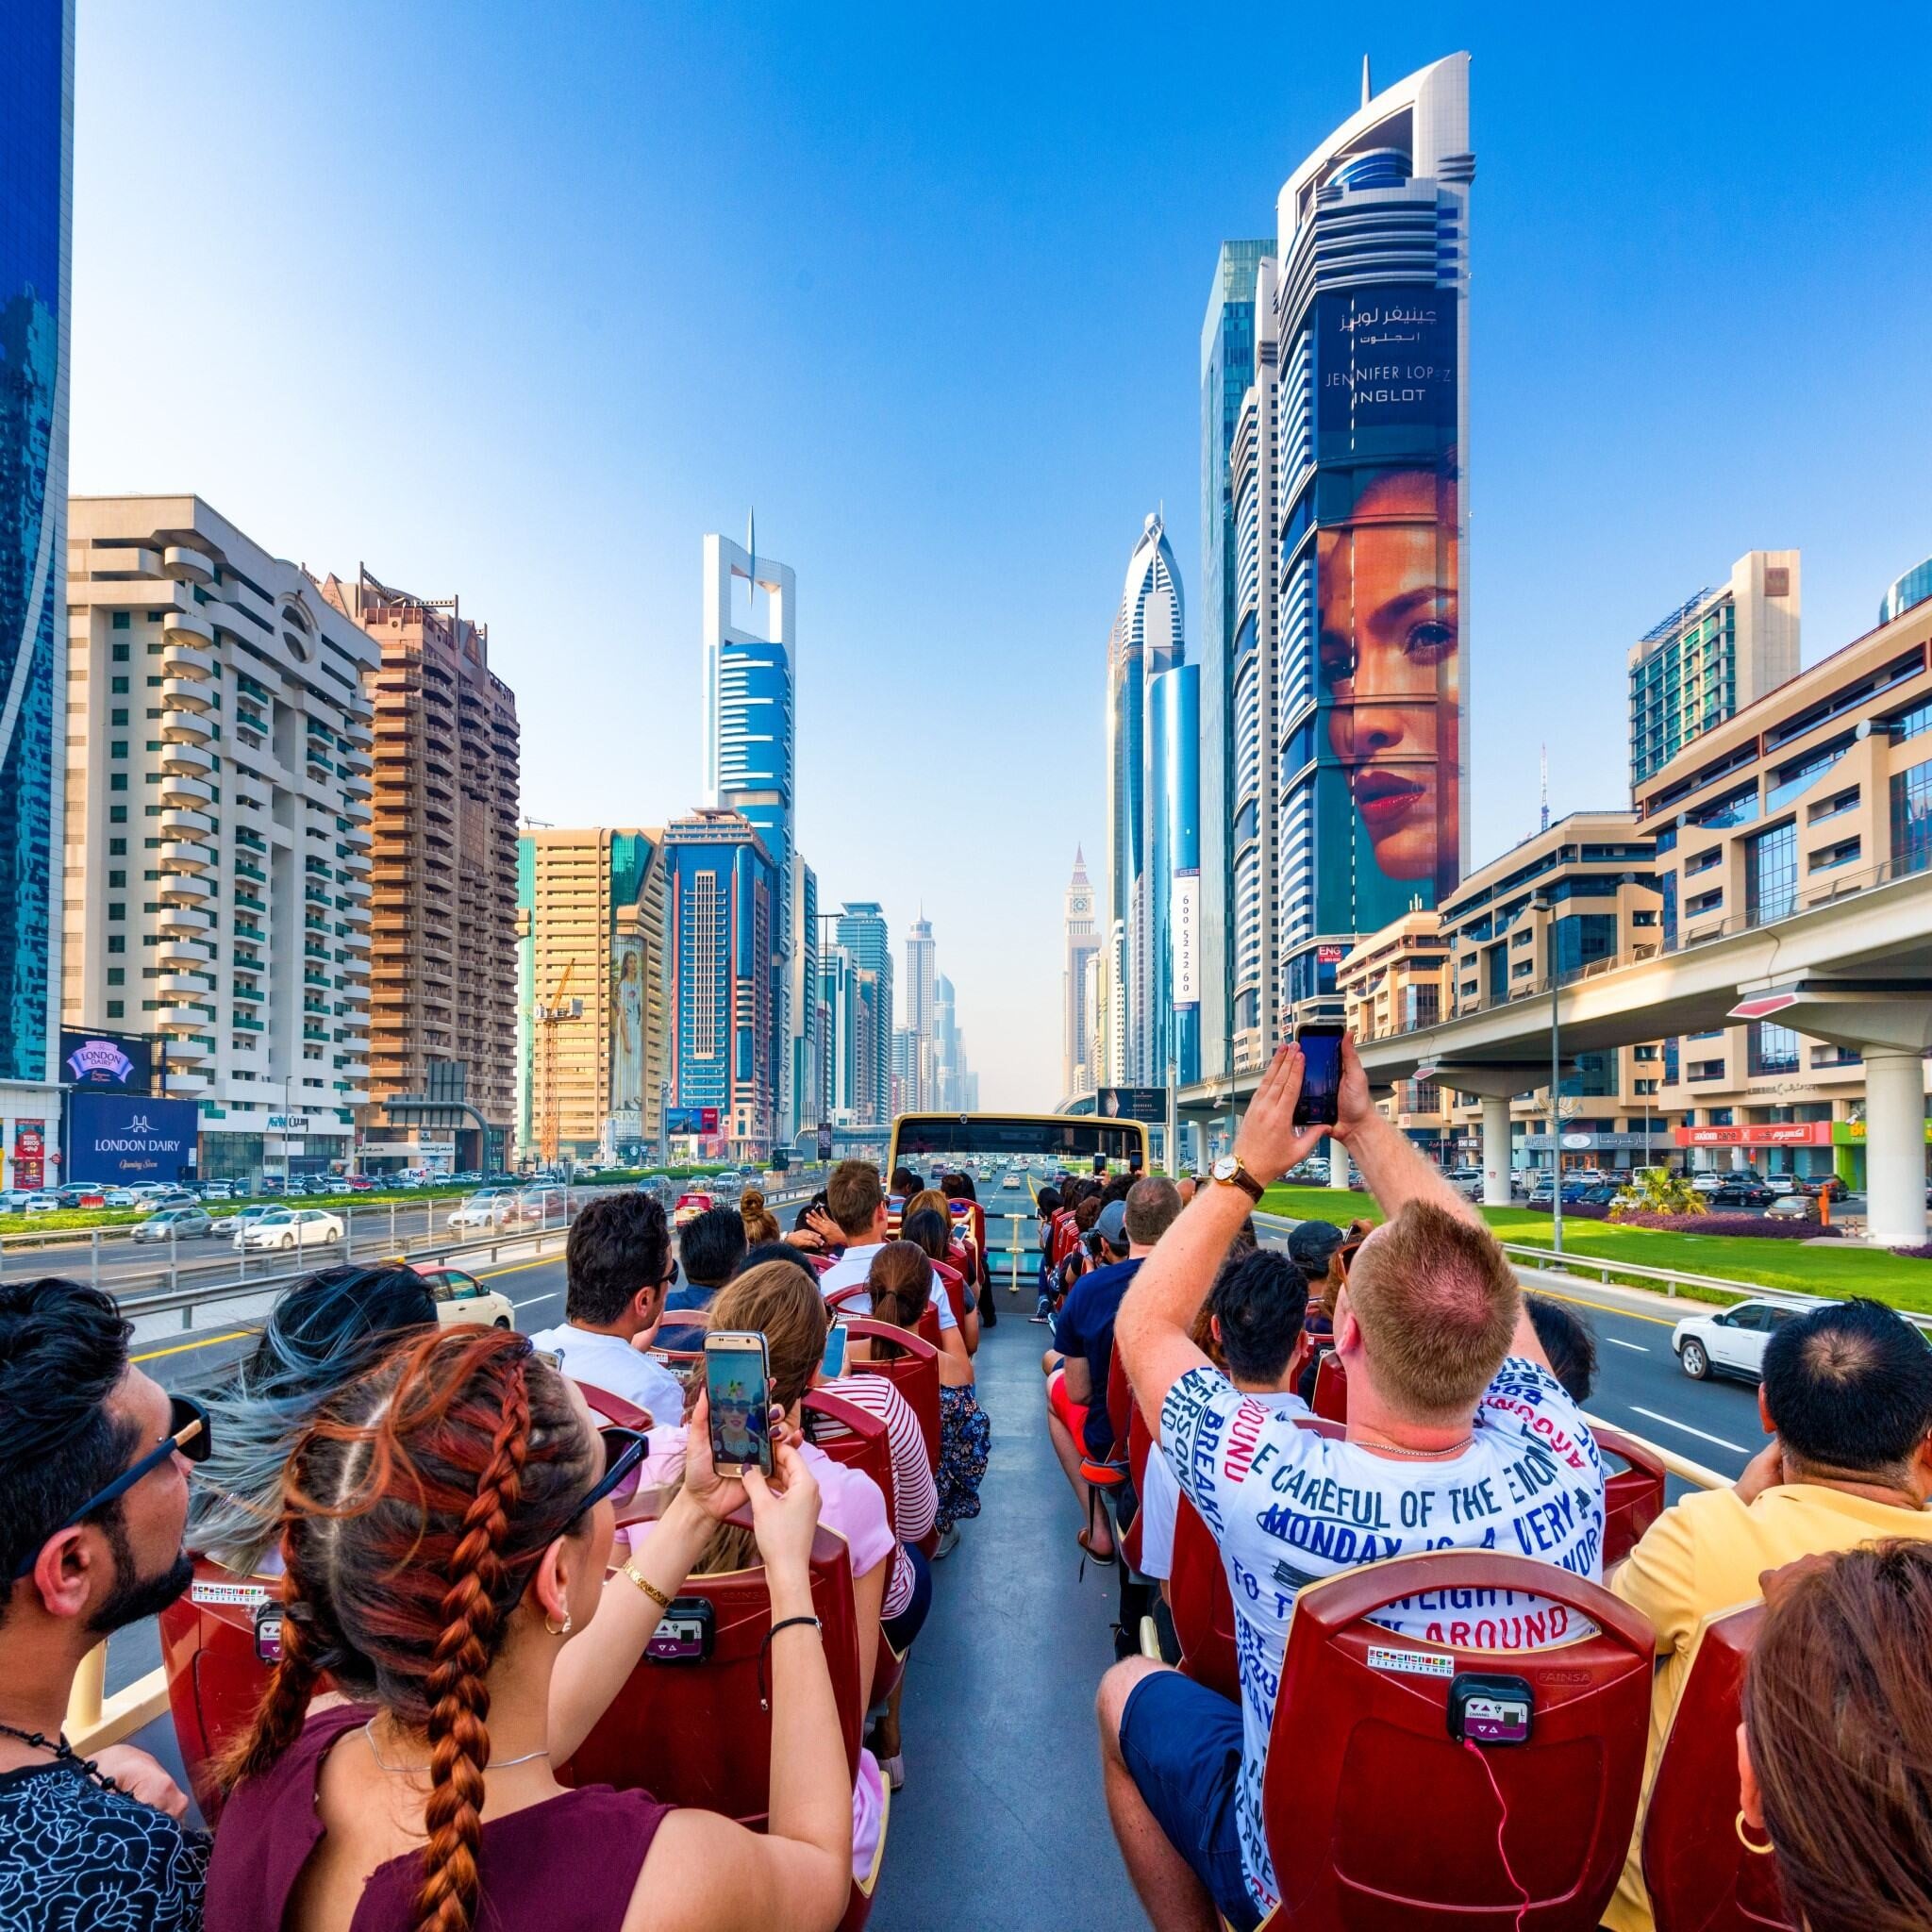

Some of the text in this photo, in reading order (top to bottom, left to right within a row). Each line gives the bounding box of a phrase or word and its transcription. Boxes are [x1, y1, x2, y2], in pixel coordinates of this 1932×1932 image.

[1325, 366, 1400, 388] JENNIFER
[1354, 389, 1426, 404] INGLOT
[81, 1051, 122, 1065] LONDON
[95, 1139, 180, 1152] LONDON DAIRY
[119, 1159, 143, 1170] Opening
[1224, 1396, 1271, 1484] ROUND
[1271, 1464, 1391, 1528] CAREFUL
[1400, 1491, 1435, 1527] OF
[1448, 1476, 1503, 1524] THE
[1262, 1502, 1403, 1565] MONDAY
[1513, 1491, 1575, 1556] VERY
[1425, 1605, 1570, 1650] AROUND
